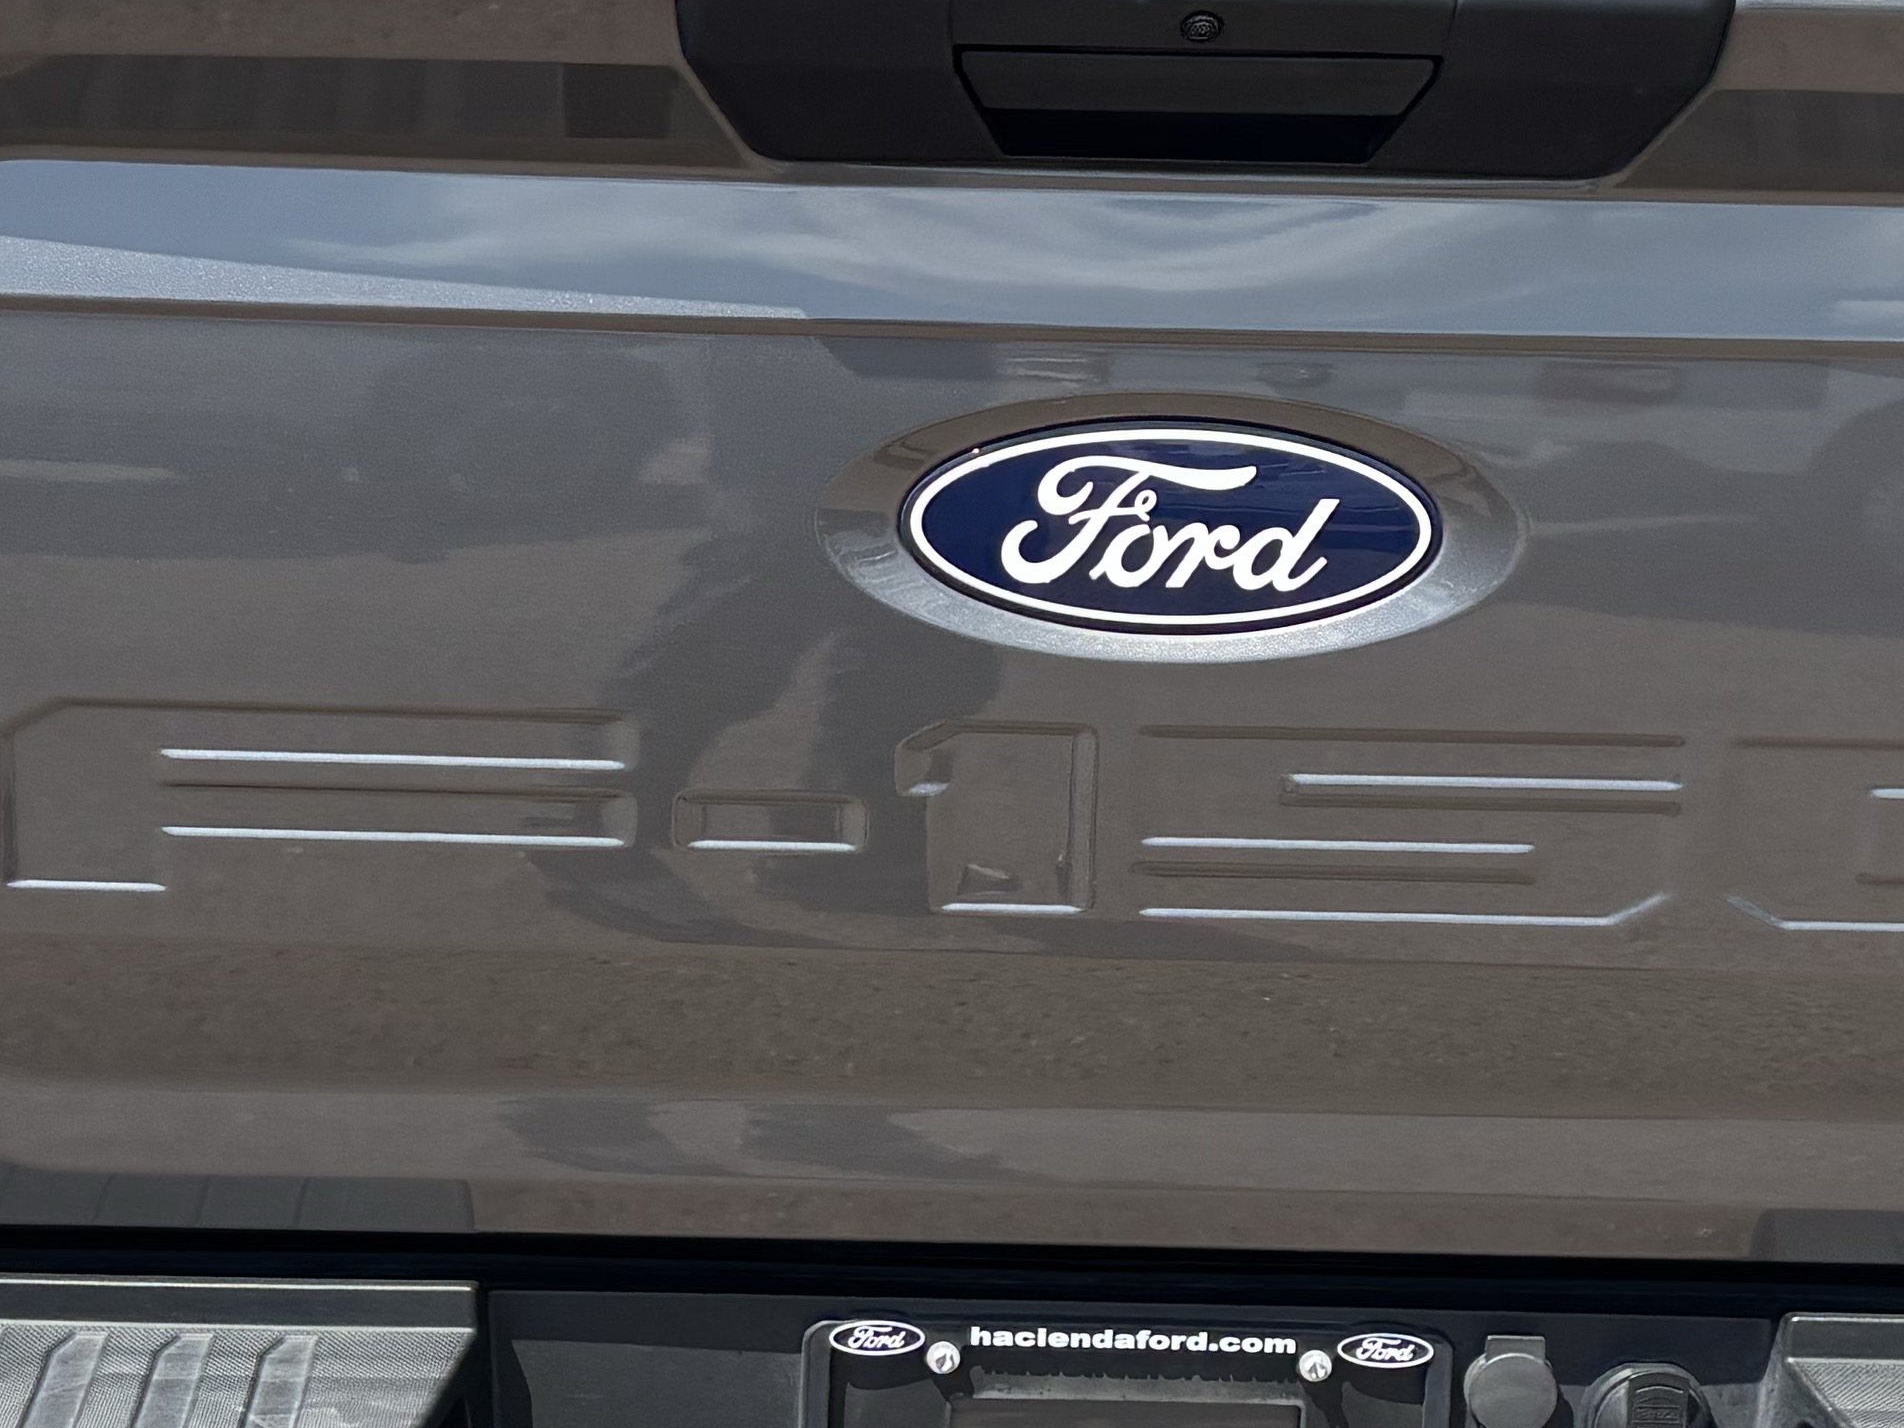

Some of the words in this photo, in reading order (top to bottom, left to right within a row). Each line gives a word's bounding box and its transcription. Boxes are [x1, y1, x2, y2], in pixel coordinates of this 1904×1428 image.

[1000, 455, 1341, 593] Ford
[847, 1325, 906, 1350] Ford
[969, 1325, 1297, 1354] haciendaford.com
[1355, 1337, 1416, 1362] Ford
